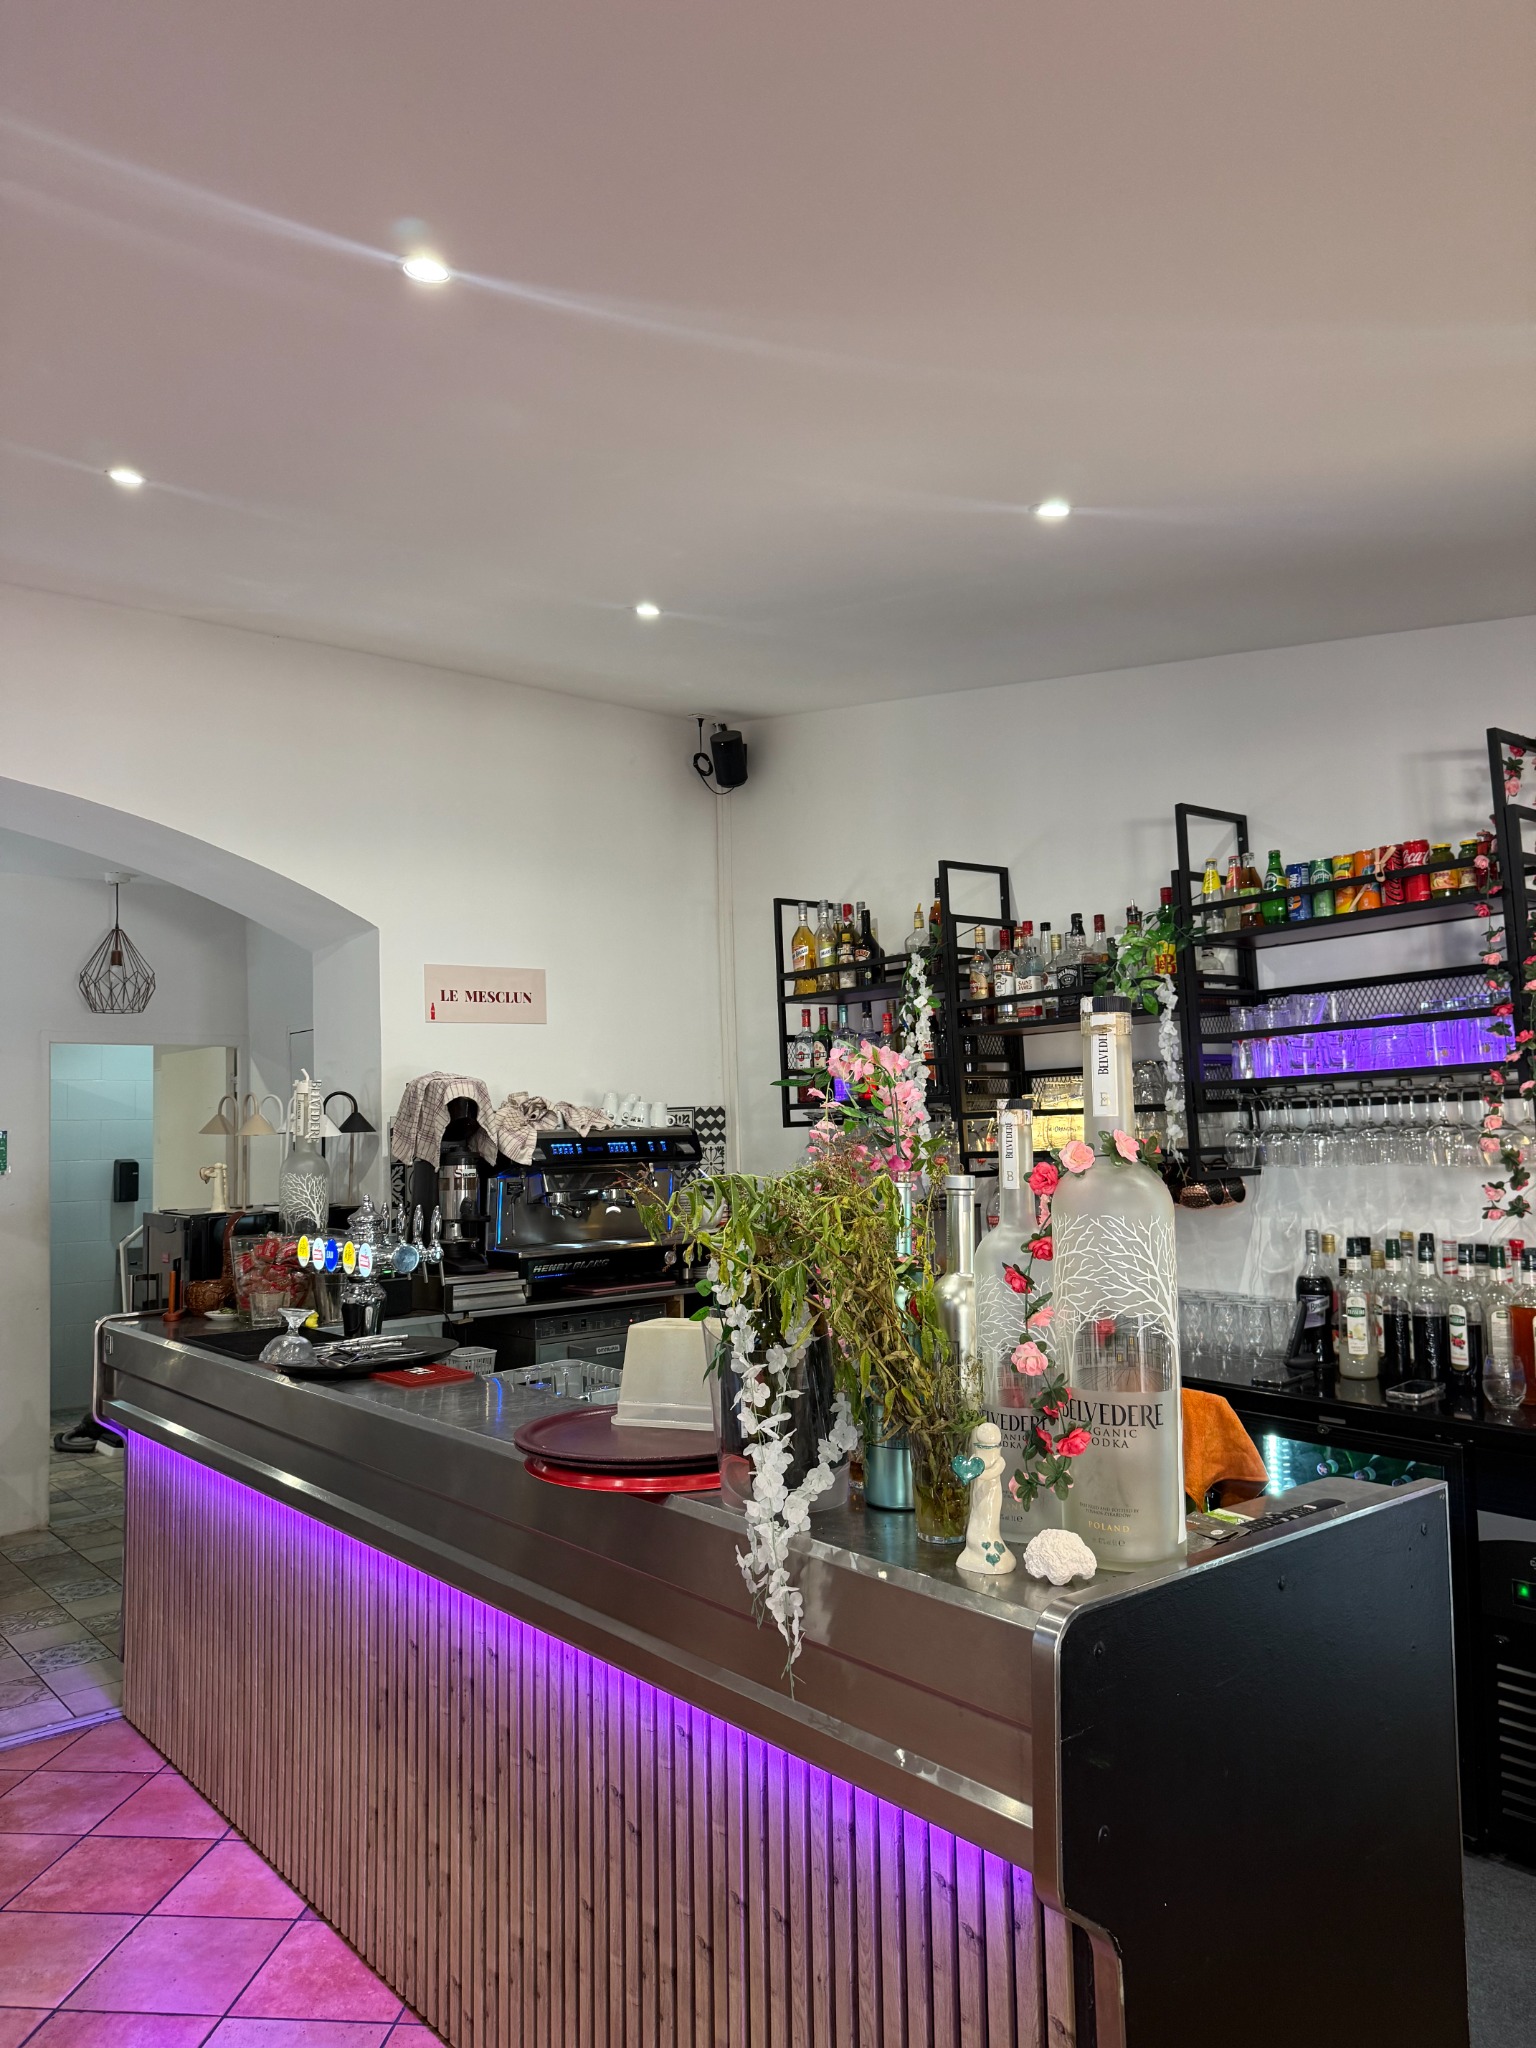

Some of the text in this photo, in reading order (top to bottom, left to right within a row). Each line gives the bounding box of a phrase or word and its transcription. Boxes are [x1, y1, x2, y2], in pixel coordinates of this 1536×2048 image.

[1402, 850, 1431, 866] Coca-C
[1154, 953, 1177, 974] J&B
[440, 989, 532, 1003] LE MESCLUN
[1098, 1034, 1109, 1075] BELVEDE
[308, 1080, 322, 1143] BELVEDERE
[1005, 1122, 1014, 1159] BELVEDERE
[533, 1259, 610, 1273] HENRY BLANC
[1062, 1398, 1164, 1430] BELVEDERE
[1092, 1426, 1138, 1439] GANIC
[1091, 1437, 1130, 1449] ODKA
[1088, 1520, 1130, 1533] POLAND
